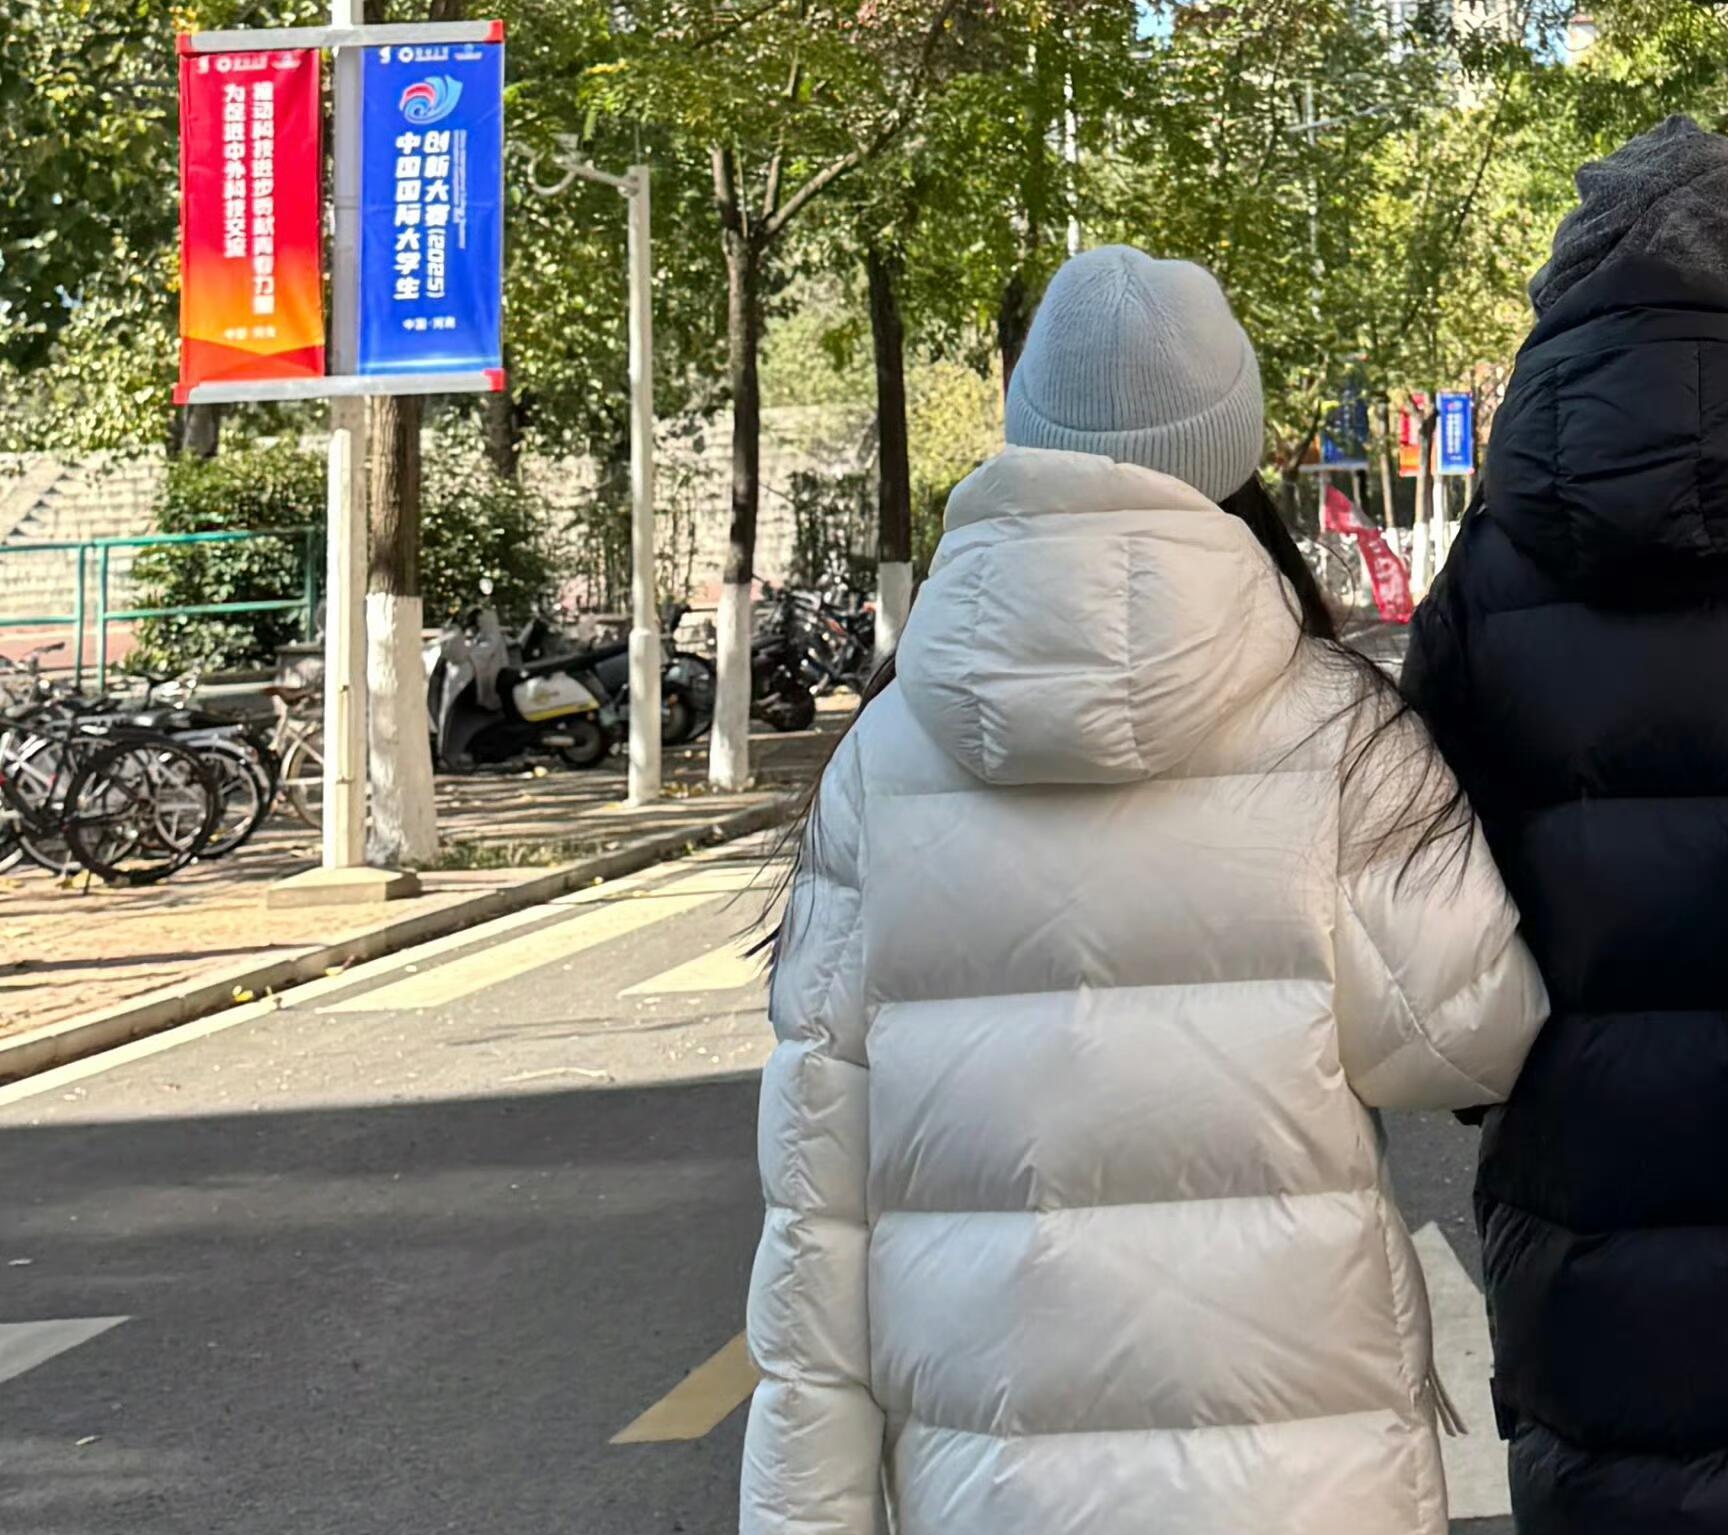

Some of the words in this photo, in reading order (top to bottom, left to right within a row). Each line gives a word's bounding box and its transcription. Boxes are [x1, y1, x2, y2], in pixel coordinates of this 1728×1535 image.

[393, 131, 422, 300] 中国国际大学生
